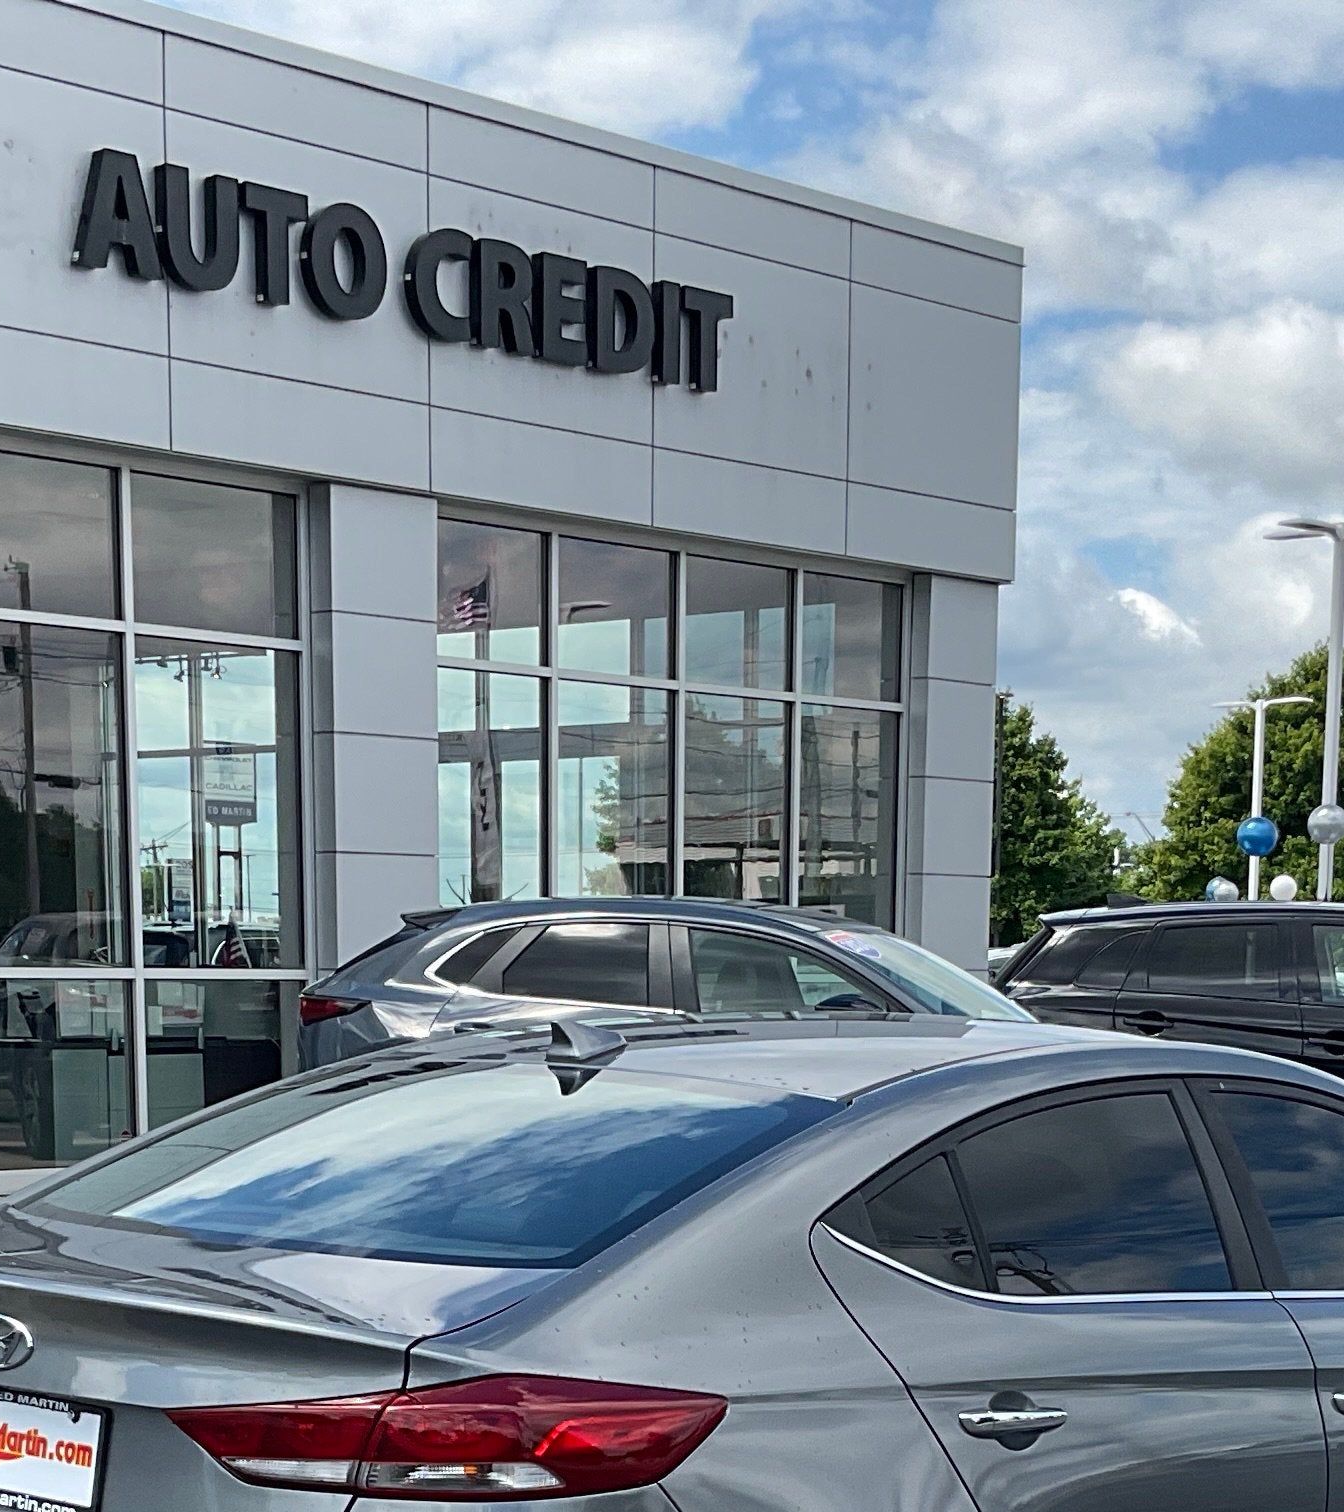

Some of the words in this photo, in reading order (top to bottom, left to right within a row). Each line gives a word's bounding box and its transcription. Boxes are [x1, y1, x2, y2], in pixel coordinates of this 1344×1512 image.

[72, 148, 387, 321] AUTO
[404, 227, 733, 392] CREDIT
[205, 783, 254, 792] CADILLAC
[207, 806, 219, 815] ED
[221, 806, 253, 817] MARTIN
[17, 1394, 70, 1413] MARTIN
